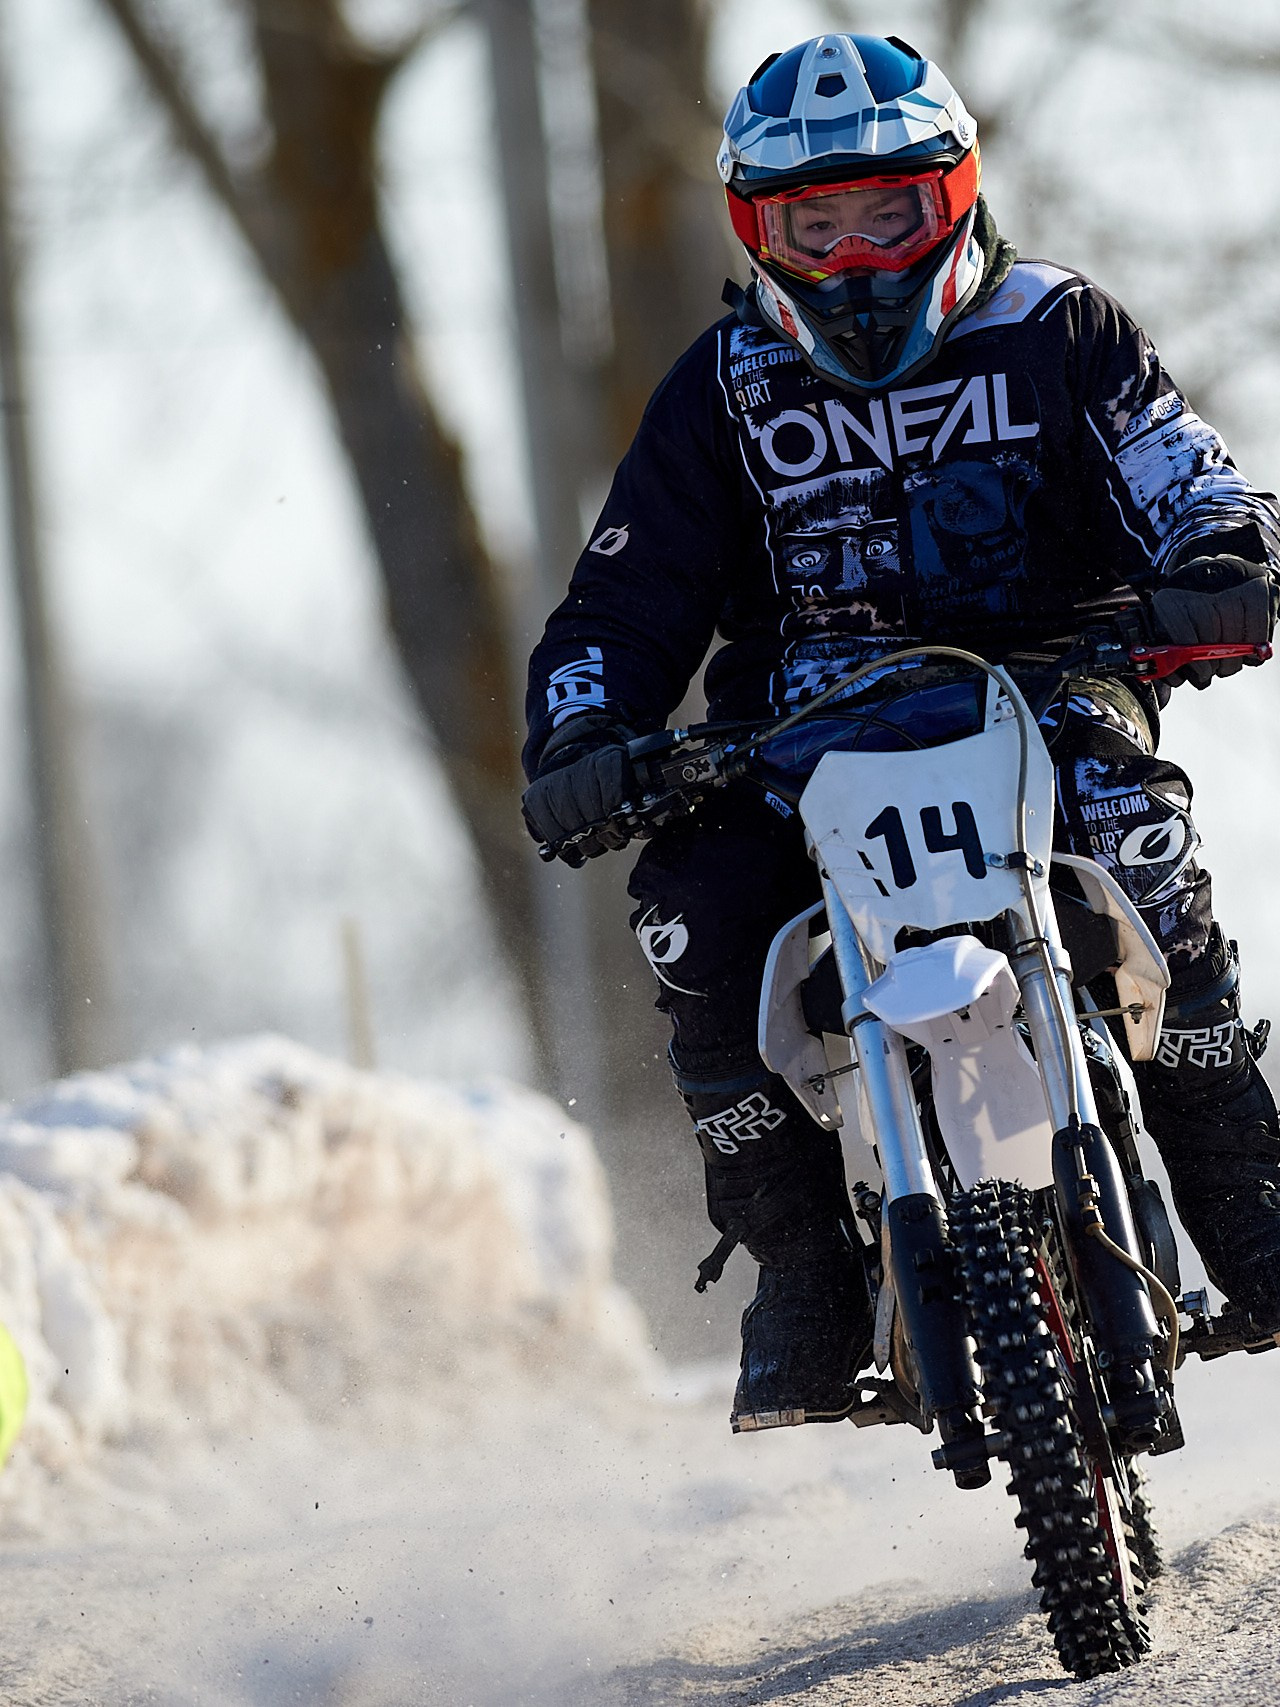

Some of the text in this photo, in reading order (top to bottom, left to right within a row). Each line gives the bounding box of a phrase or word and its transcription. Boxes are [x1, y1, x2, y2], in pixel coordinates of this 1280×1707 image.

[732, 369, 766, 390] TO THE
[1085, 817, 1121, 835] TO THE
[864, 801, 988, 890] 14
